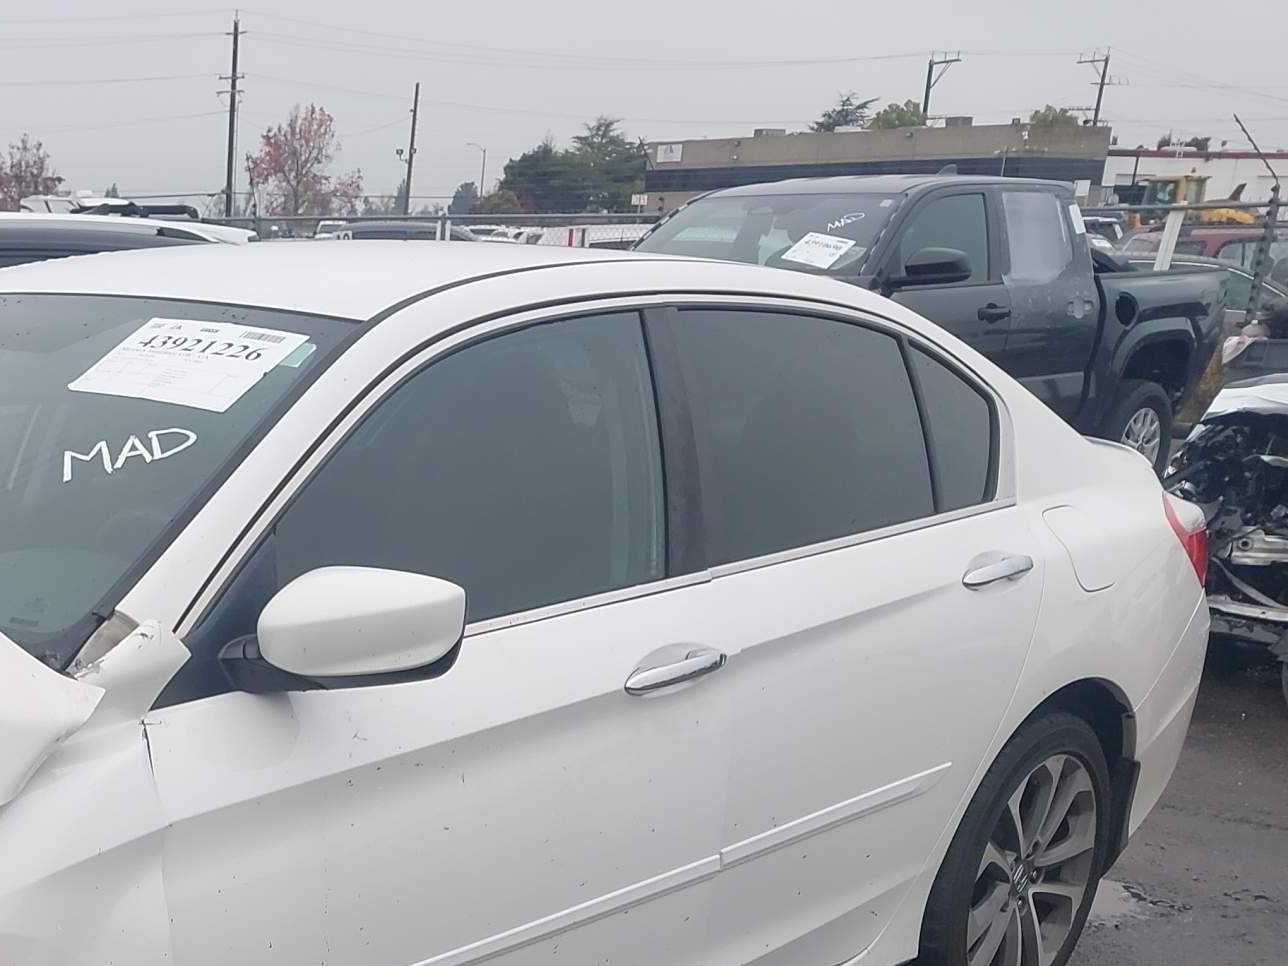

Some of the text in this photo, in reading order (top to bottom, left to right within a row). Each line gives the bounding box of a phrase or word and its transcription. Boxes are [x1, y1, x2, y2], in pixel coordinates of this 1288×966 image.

[826, 212, 865, 232] MAD
[138, 334, 270, 361] 43921226
[61, 427, 198, 483] MAD
